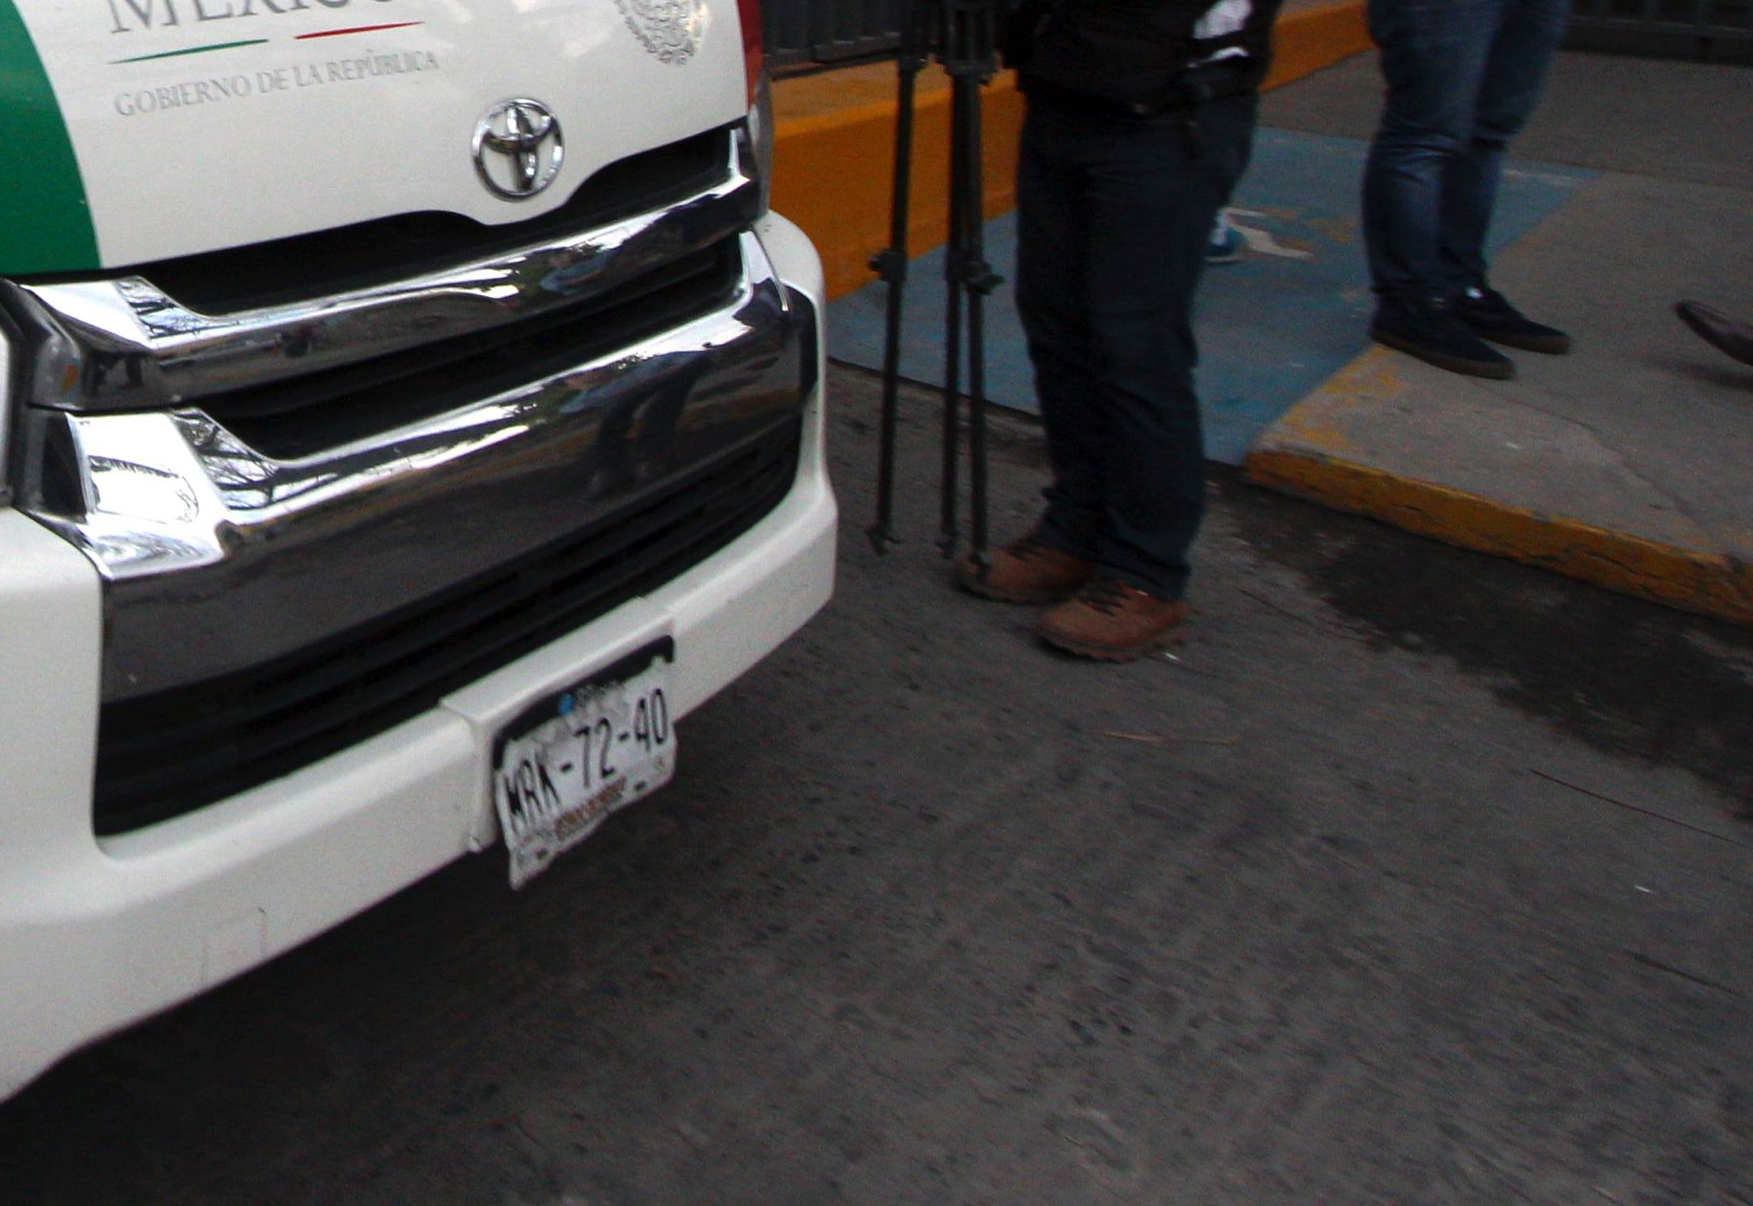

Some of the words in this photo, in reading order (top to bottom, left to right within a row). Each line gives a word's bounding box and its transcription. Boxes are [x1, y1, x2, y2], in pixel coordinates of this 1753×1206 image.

[114, 74, 252, 116] GOBIERNO
[259, 69, 290, 94] DE
[294, 64, 324, 87] LA
[326, 50, 441, 83] REPÚBLICA
